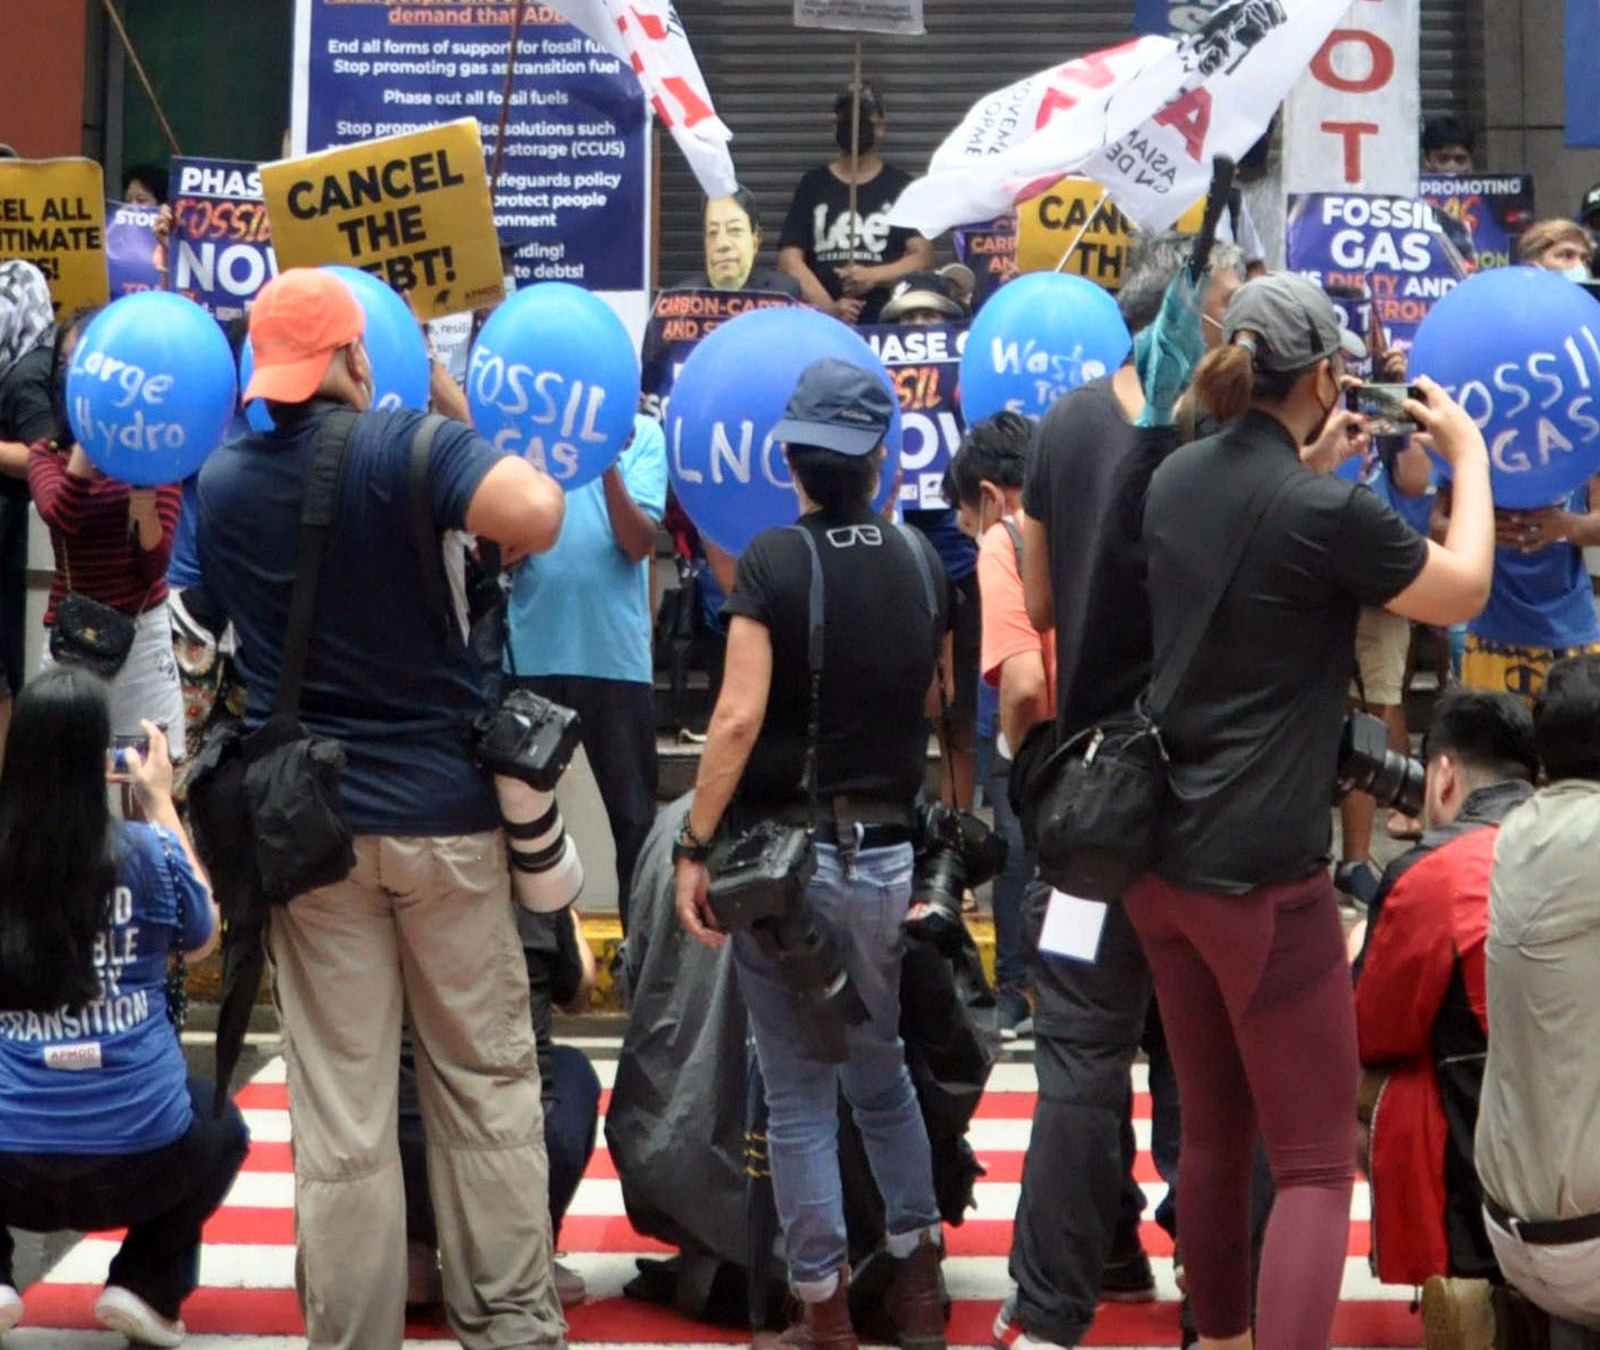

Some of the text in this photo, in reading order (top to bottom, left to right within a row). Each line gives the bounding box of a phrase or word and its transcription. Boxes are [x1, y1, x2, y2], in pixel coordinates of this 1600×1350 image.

[388, 6, 473, 24] demand
[328, 39, 358, 54] End
[362, 39, 381, 54] all
[384, 39, 430, 55] forms
[433, 39, 450, 54] of
[452, 40, 510, 58] support
[517, 38, 539, 54] for
[542, 38, 582, 54] fossil
[333, 60, 371, 77] Stop
[373, 60, 456, 78] promoting
[460, 62, 489, 78] gas
[512, 58, 586, 75] transition
[588, 59, 620, 75] fuel
[383, 89, 569, 106] Phase out all fosil fuels
[337, 121, 616, 138] Stop solutions such
[571, 141, 626, 159] (CCUS)
[179, 166, 263, 197] PHAS
[287, 149, 465, 220] CANCEL
[574, 172, 622, 191] policy
[1420, 178, 1521, 195] PROMOTING
[41, 197, 93, 221] ALL
[553, 192, 608, 210] people
[1322, 197, 1444, 234] FOSSIL
[338, 206, 428, 257] THE
[813, 202, 892, 254] Lee
[1330, 229, 1432, 273] GAS
[175, 240, 280, 296] NO
[362, 246, 457, 296] EBT!
[534, 263, 585, 279] debts!
[1403, 276, 1458, 298] AND
[663, 319, 698, 342] AND
[71, 334, 175, 406] Large
[470, 346, 608, 443] FOSSIL
[74, 396, 187, 452] Hydro
